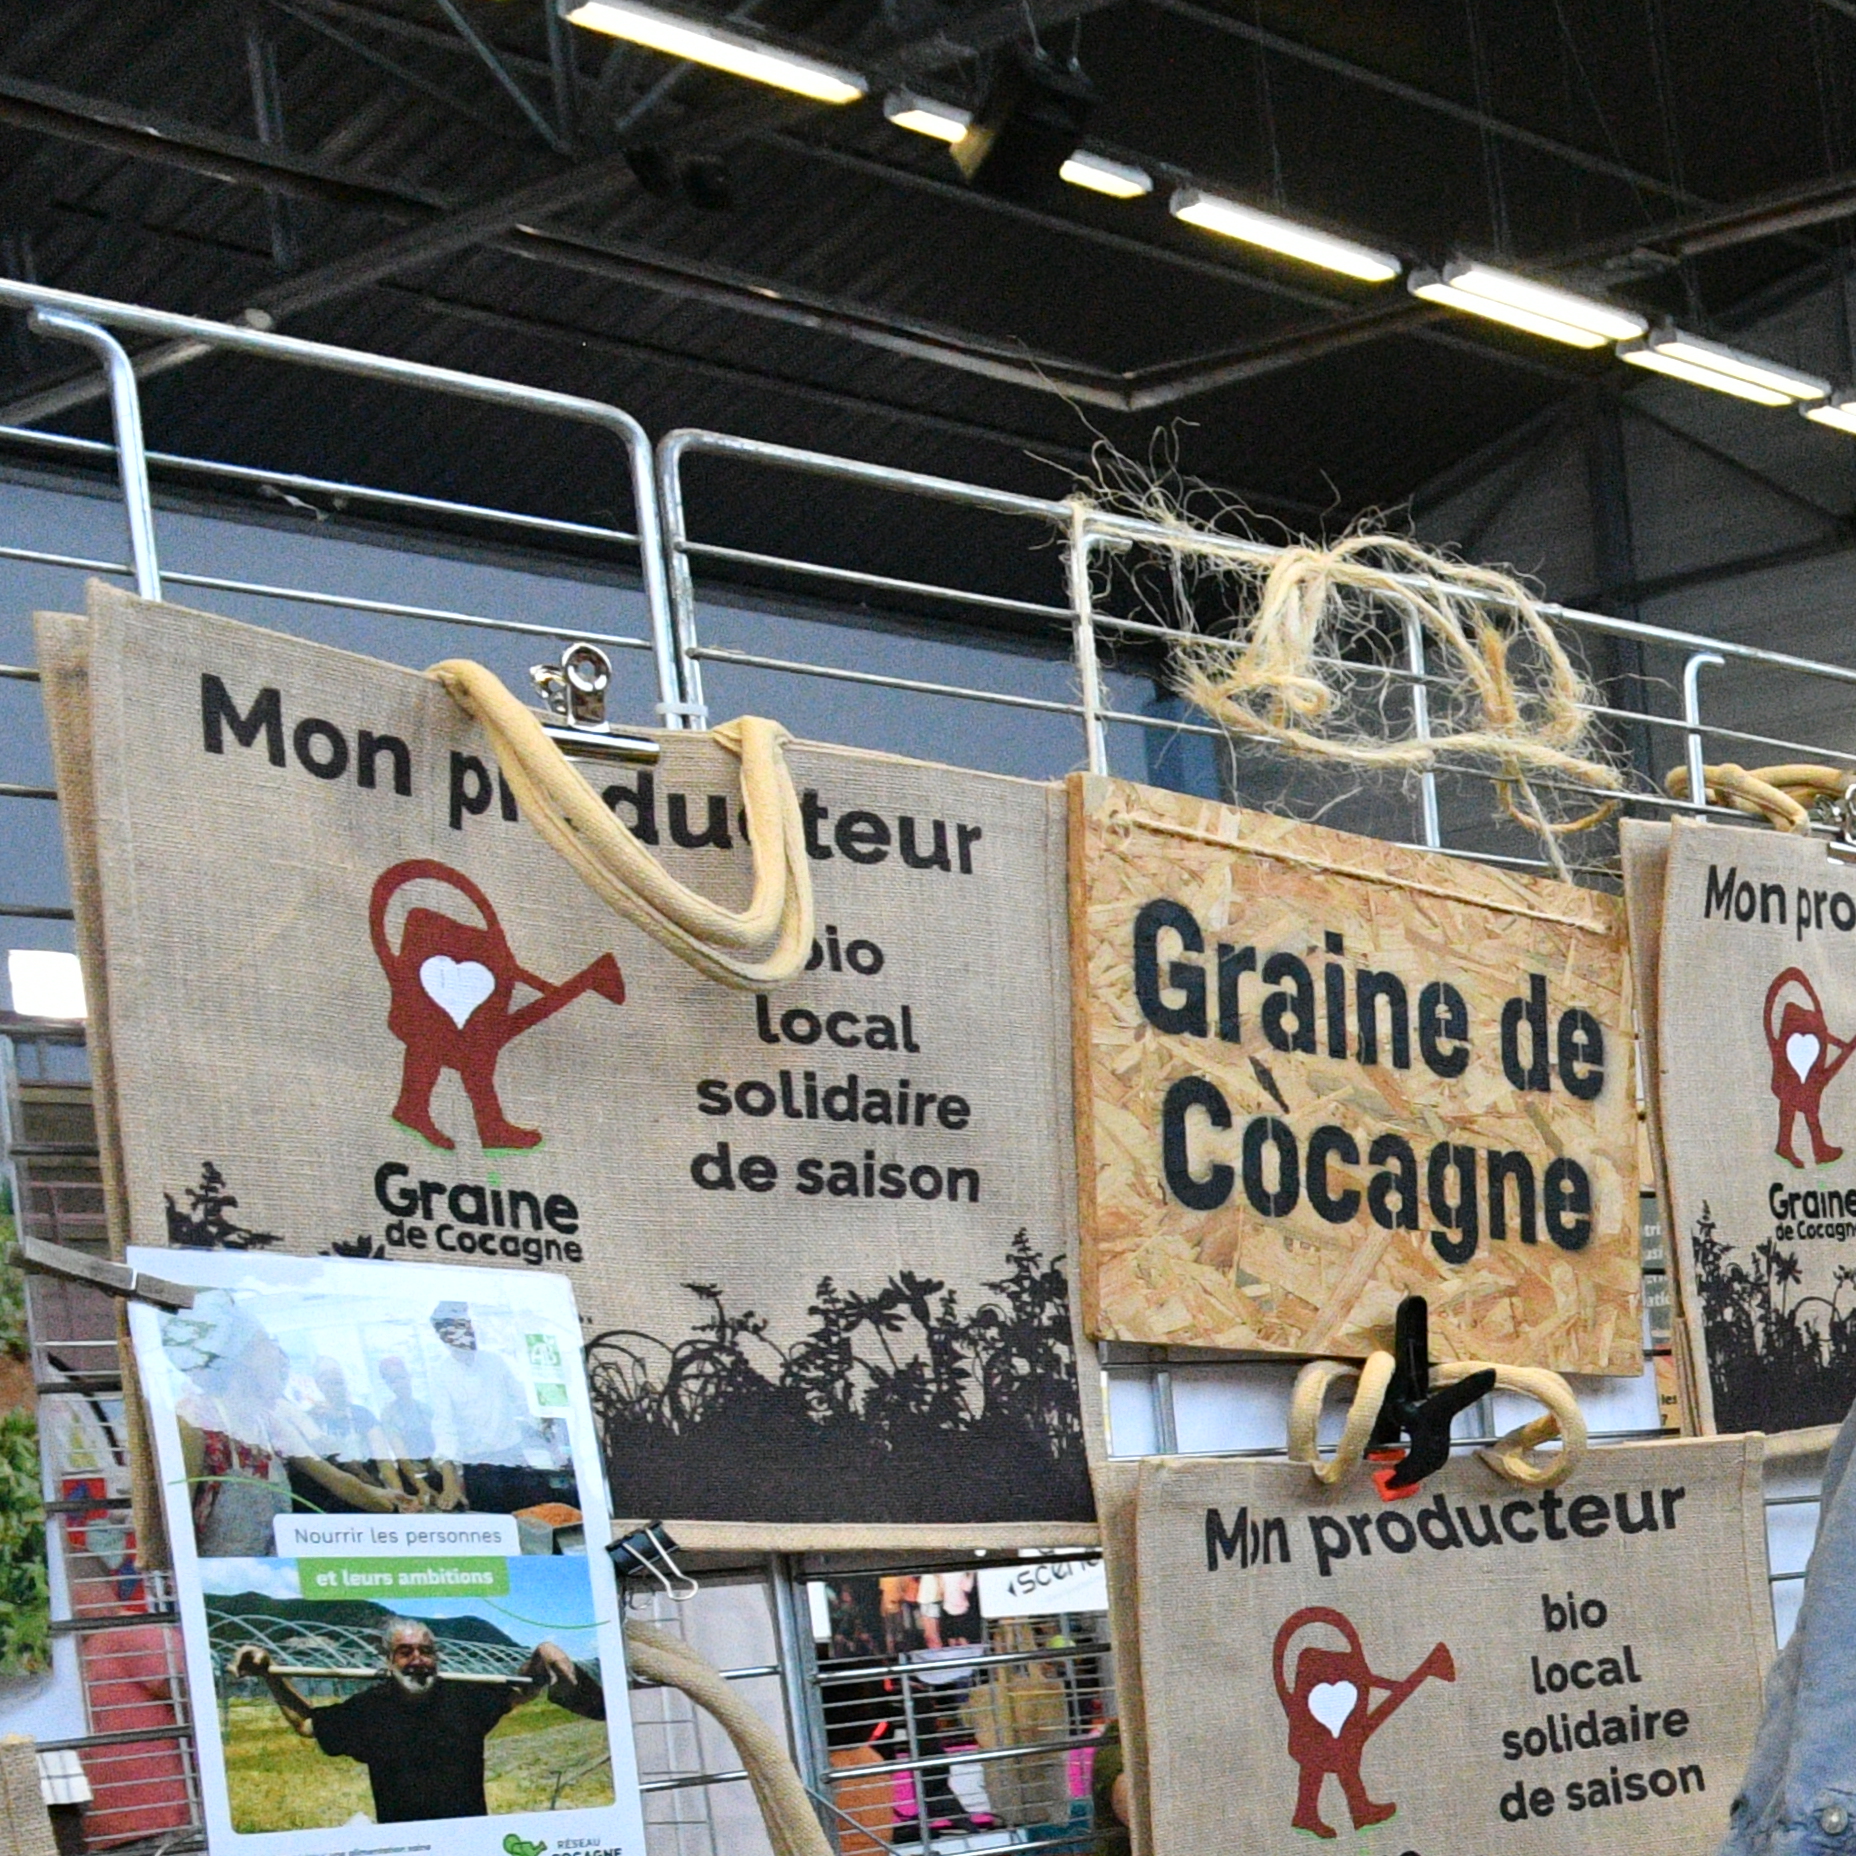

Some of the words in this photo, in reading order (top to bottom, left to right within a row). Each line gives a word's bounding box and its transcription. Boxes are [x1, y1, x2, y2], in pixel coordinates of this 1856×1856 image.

[199, 673, 413, 797] Mon
[1704, 864, 1787, 925] Mon
[757, 995, 920, 1055] local
[1133, 898, 1472, 1079] Graine
[1501, 973, 1605, 1100] de
[697, 1071, 972, 1132] solidaire
[373, 1163, 580, 1235] Graine
[690, 1143, 778, 1193] de
[798, 1148, 981, 1204] saison
[385, 1219, 428, 1251] de
[435, 1226, 584, 1266] Cocagne
[1776, 1222, 1795, 1241] de
[295, 1526, 365, 1545] Nourrir
[371, 1526, 399, 1544] les
[406, 1526, 502, 1547] personnes
[1311, 1487, 1685, 1576] producteur
[316, 1569, 337, 1587] et
[342, 1567, 393, 1587] leurs
[399, 1566, 494, 1587] ambitions
[1541, 1591, 1608, 1631] bio
[1532, 1647, 1641, 1695] local
[1502, 1705, 1690, 1760] solidaire
[1501, 1783, 1554, 1822] de
[1566, 1761, 1705, 1812] saison
